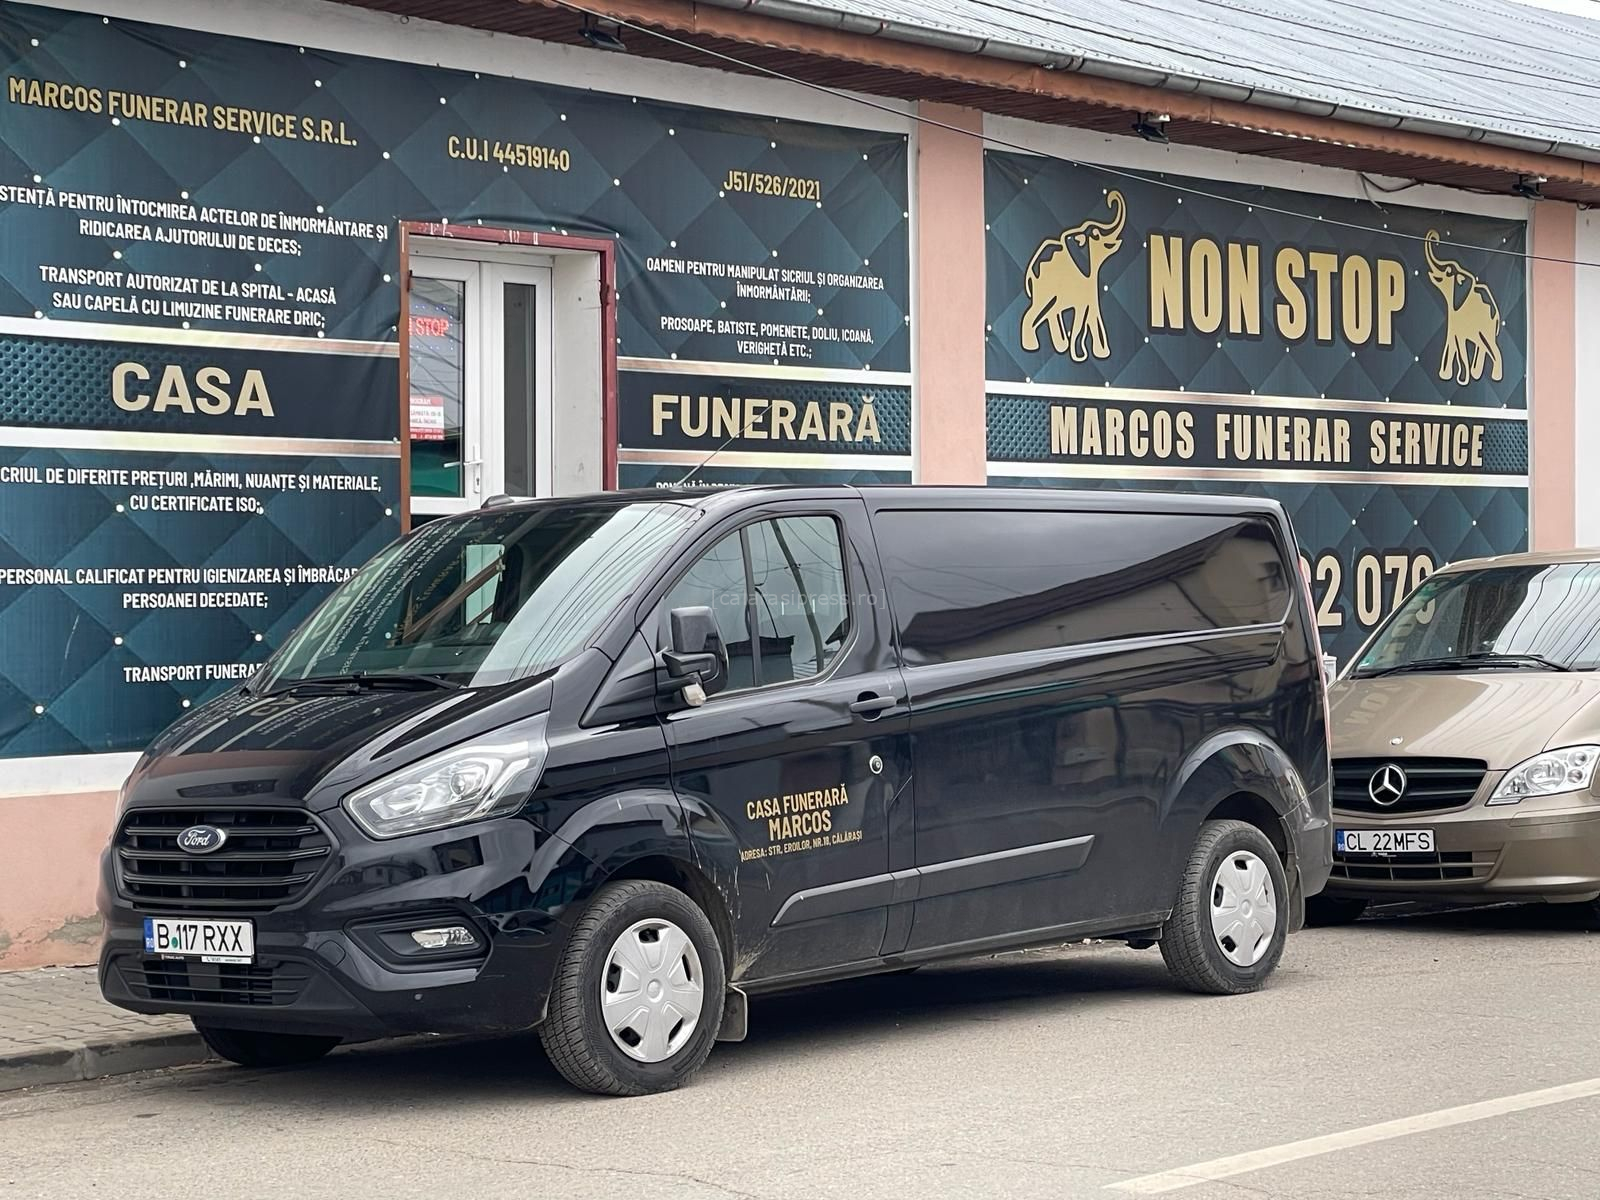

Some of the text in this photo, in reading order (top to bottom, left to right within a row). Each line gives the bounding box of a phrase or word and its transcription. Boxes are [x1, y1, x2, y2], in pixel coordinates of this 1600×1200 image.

[10, 78, 356, 145] MARCOS FUNERAR SERVICE S.R.L.
[449, 136, 569, 171] C.U.I 44519140
[724, 171, 819, 200] J51/526/2021
[59, 192, 113, 212] PENTRU
[117, 194, 197, 221] ÎNTOCMIREA
[200, 207, 258, 227] ACTELOR
[261, 213, 277, 229] DE
[279, 211, 373, 238] ÎNMORMÂNTARE
[376, 225, 387, 241] ȘI
[80, 219, 301, 256] RIDICAREA AJUTORULUI DE DECES;
[39, 266, 123, 287] TRANSPORT
[126, 273, 199, 293] AUTORIZAT
[202, 280, 218, 295] DE
[222, 281, 238, 297] LA
[242, 283, 285, 300] SPITAL
[296, 287, 336, 304] ACASĂ
[647, 258, 884, 290] OAMENI PENTRU MANIPULAT SICRIUL ȘI ORGANIZAREA
[1151, 235, 1404, 344] NON STOP
[53, 292, 325, 328] SAU CAPELĂ CU LIMUZINE FUNERARE DRIC;
[415, 317, 449, 337] STOP
[661, 317, 873, 344] PROSOAPE, BATISTE, POMENETE, DOLIU, ICOANĂ,
[737, 341, 811, 359] VERIGHETĂ ETC.;
[113, 363, 274, 416] CASA
[653, 394, 882, 443] FUNERARĂ
[1051, 406, 1484, 466] MARCOS FUNERAR SERVICE
[1, 467, 42, 483] CRIUL
[46, 468, 64, 483] DE
[68, 469, 128, 485] DIFERITE
[132, 471, 187, 489] PREȚURI
[246, 474, 296, 492] NUANȚE
[299, 475, 309, 492] ȘI
[313, 475, 381, 492] MATERIALE,
[130, 495, 148, 510] CU
[152, 496, 233, 511] CERTIFICATE
[0, 569, 73, 584] PERSONAL
[76, 569, 145, 584] CALIFICAT
[149, 569, 200, 583] PENTRU
[204, 568, 281, 583] IGIENIZAREA
[284, 568, 295, 586] ȘI
[1300, 555, 1342, 627] 2
[124, 592, 268, 608] PERSOANEI DECEDATE;
[124, 664, 262, 682] TRANSPORT FUNERA
[747, 784, 848, 819] CASA FUNERARĂ
[184, 829, 212, 846] Ford
[769, 810, 831, 841] MARCOS
[741, 848, 767, 862] ADRESA:
[1346, 833, 1367, 851] CL
[157, 923, 244, 952] B 117 RXX
